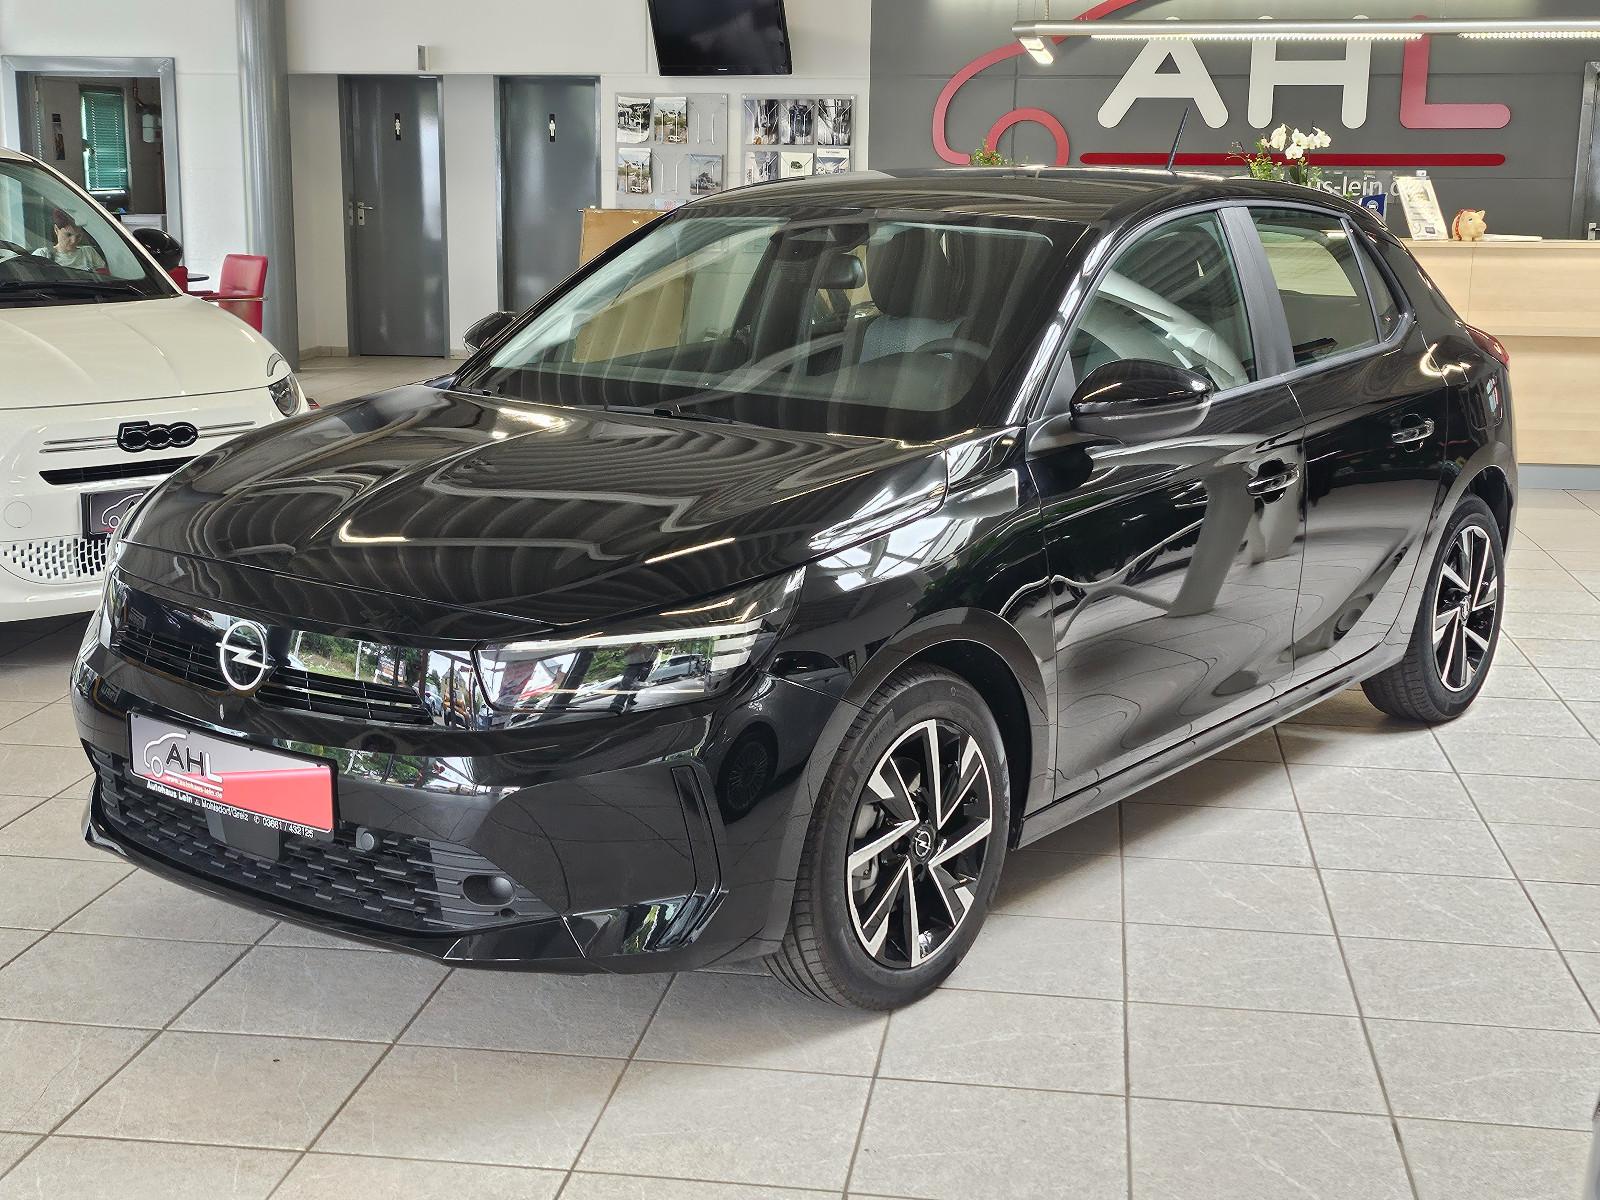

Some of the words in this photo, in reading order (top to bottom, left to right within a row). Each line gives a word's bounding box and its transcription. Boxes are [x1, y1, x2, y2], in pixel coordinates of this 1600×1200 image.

[1097, 15, 1511, 129] AHL
[117, 421, 199, 453] 500
[166, 742, 223, 783] AHL
[146, 779, 178, 799] Autohaus
[178, 791, 193, 804] Lein
[289, 825, 314, 839] 432125
